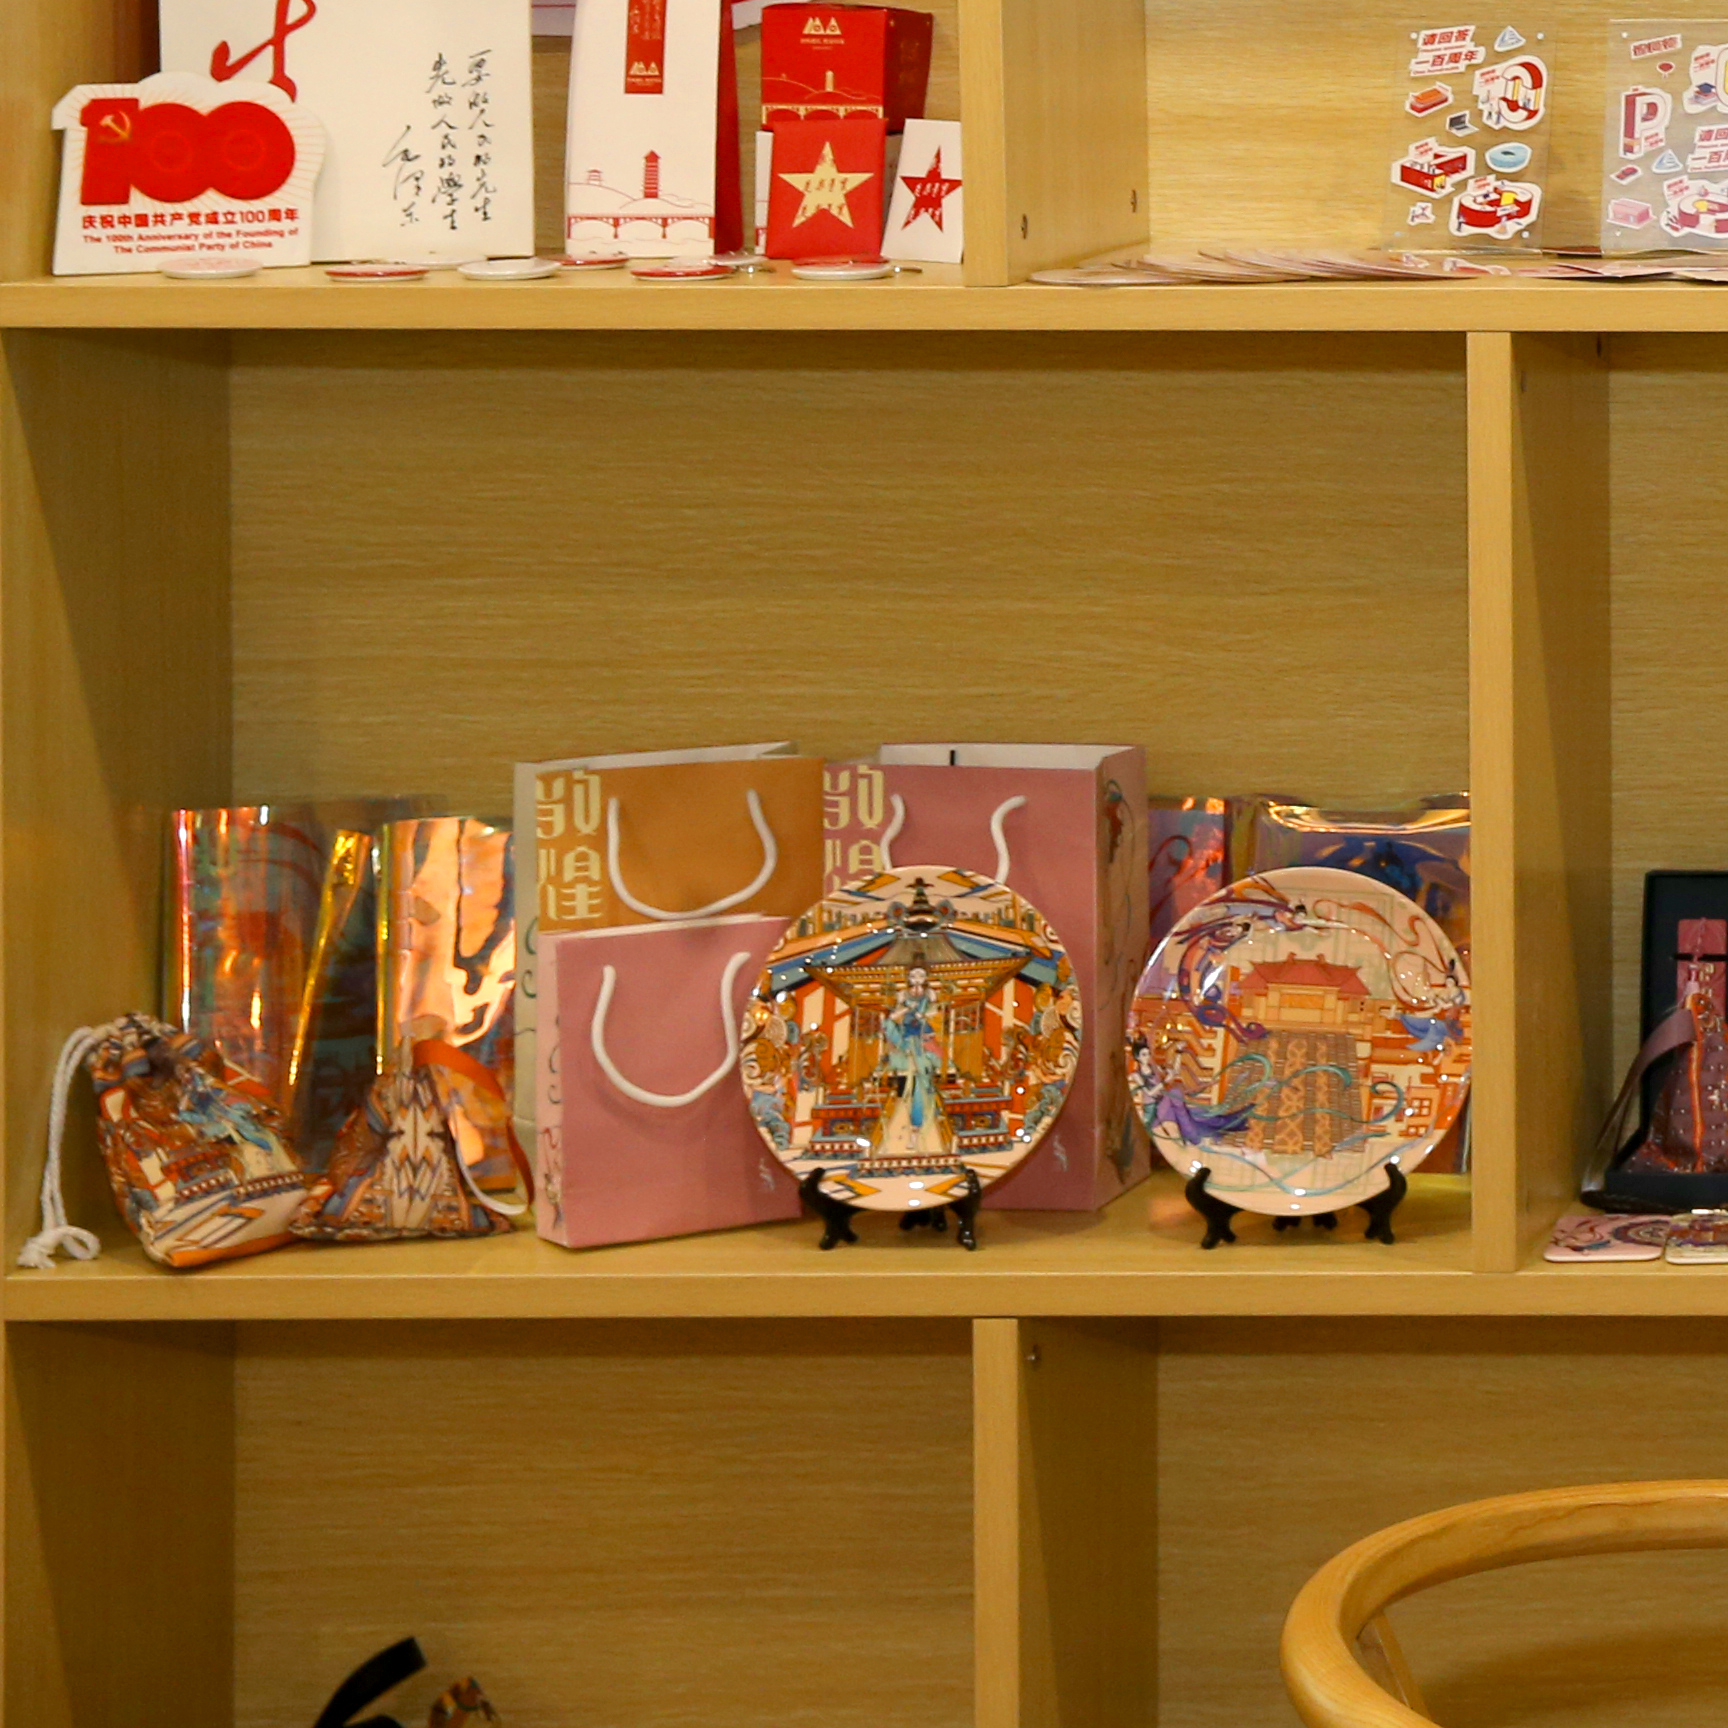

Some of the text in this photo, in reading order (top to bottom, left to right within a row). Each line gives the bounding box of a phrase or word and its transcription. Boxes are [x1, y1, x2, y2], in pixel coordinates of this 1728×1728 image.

[1423, 28, 1470, 46] 请回答
[1414, 50, 1479, 67] 一百周年
[82, 208, 299, 229] 庆祝中国共产党成立100周年
[84, 234, 101, 244] The
[137, 231, 198, 243] Anniversary
[203, 230, 214, 240] of
[217, 230, 232, 239] the
[236, 228, 284, 239] Founding
[288, 227, 299, 236] of
[113, 240, 273, 254] The Communist Party of China
